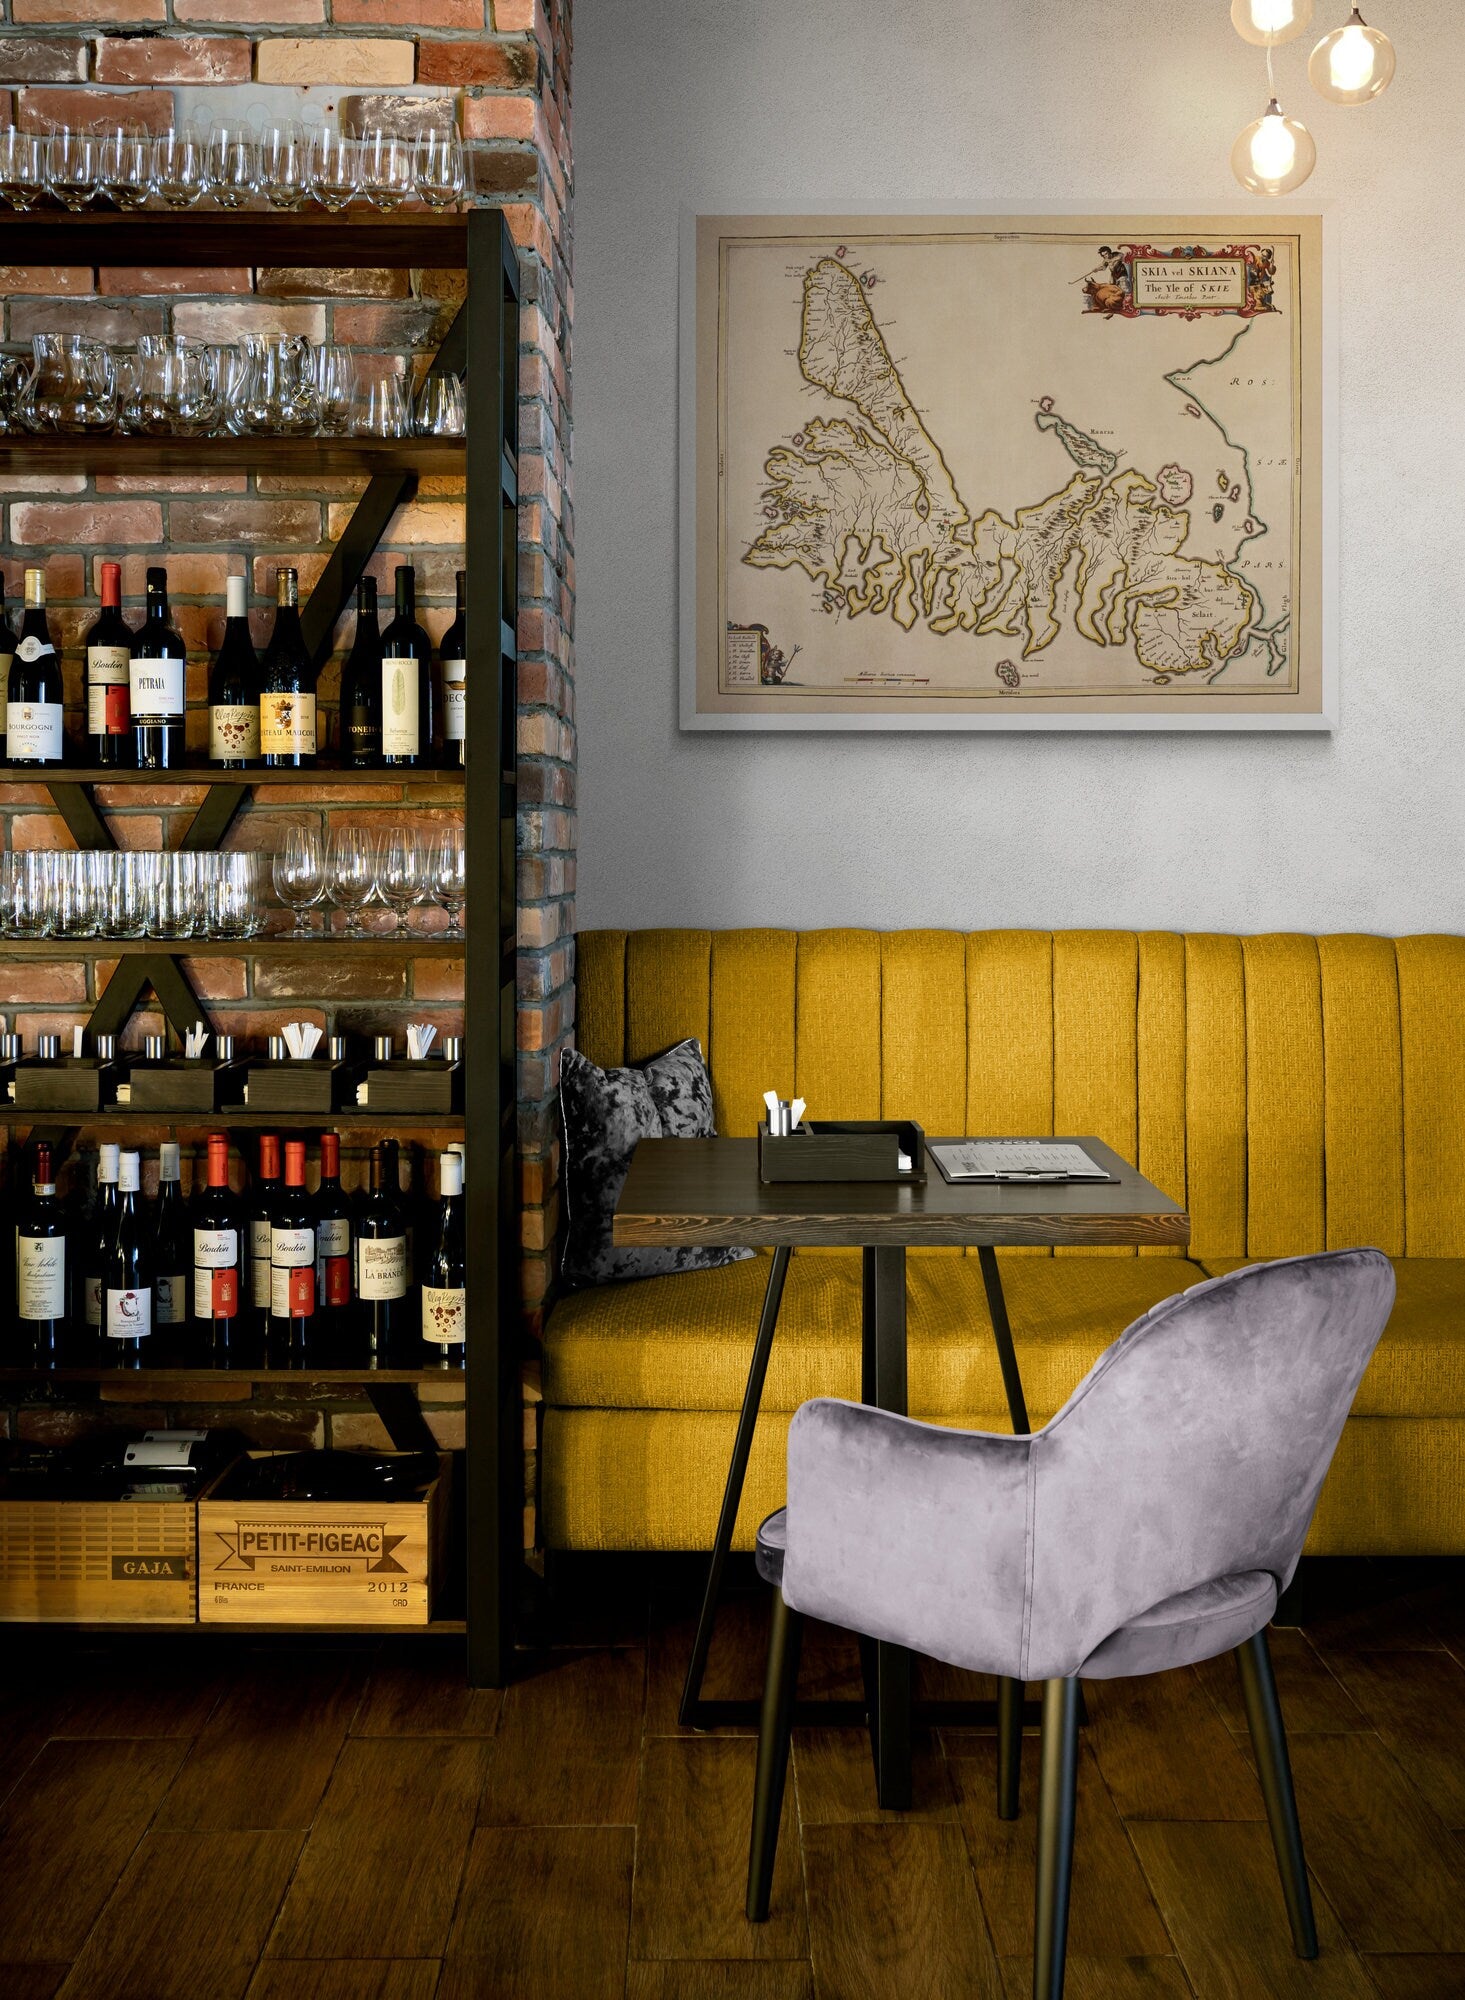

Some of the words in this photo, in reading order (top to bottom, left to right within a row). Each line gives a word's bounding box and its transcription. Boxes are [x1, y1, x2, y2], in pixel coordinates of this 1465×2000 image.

[1141, 267, 1168, 277] SKIA
[1171, 268, 1183, 276] vel
[1188, 266, 1237, 277] SKIANA
[1145, 284, 1162, 293] The
[1166, 284, 1180, 293] Yle
[1183, 284, 1194, 293] of
[1200, 284, 1230, 293] SKIE
[138, 677, 165, 690] PETRAIA
[8, 722, 54, 731] BOURGOGNE
[319, 1233, 342, 1242] ordón
[199, 1243, 230, 1253] Bordón
[275, 1241, 307, 1252] Bordón
[364, 1268, 375, 1280] LA
[242, 1532, 380, 1553] PETIT-FIGEAC
[123, 1560, 174, 1576] GAJA
[270, 1563, 352, 1573] SAINT-EMILION
[214, 1581, 265, 1591] FRANCE
[367, 1581, 409, 1593] 2012
[392, 1598, 408, 1607] CRD
